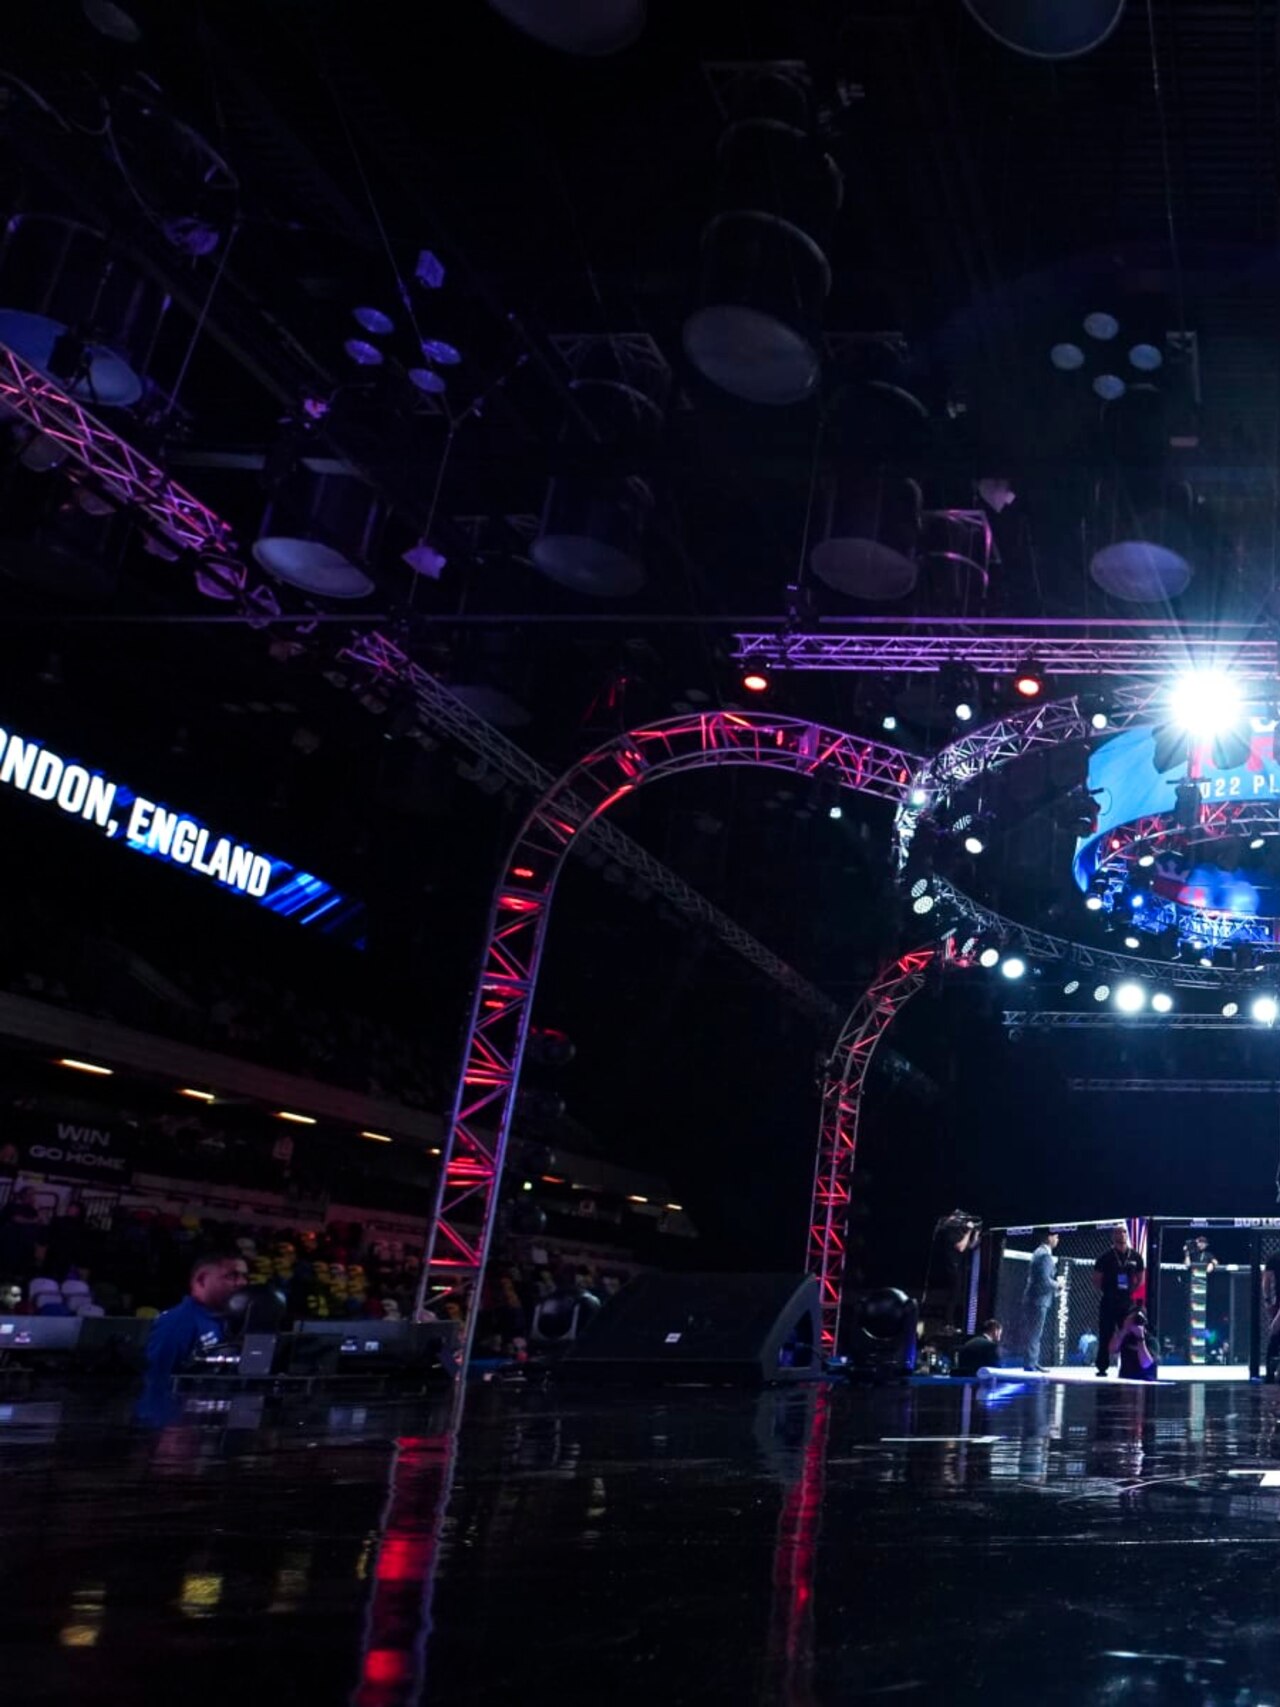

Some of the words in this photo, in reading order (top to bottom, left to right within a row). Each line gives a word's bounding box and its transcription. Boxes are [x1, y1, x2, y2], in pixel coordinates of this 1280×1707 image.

[1200, 776, 1241, 799] 022
[126, 796, 272, 898] ENGLAND
[56, 1121, 112, 1147] WIN
[28, 1144, 64, 1161] GO
[65, 1150, 127, 1171] HOME
